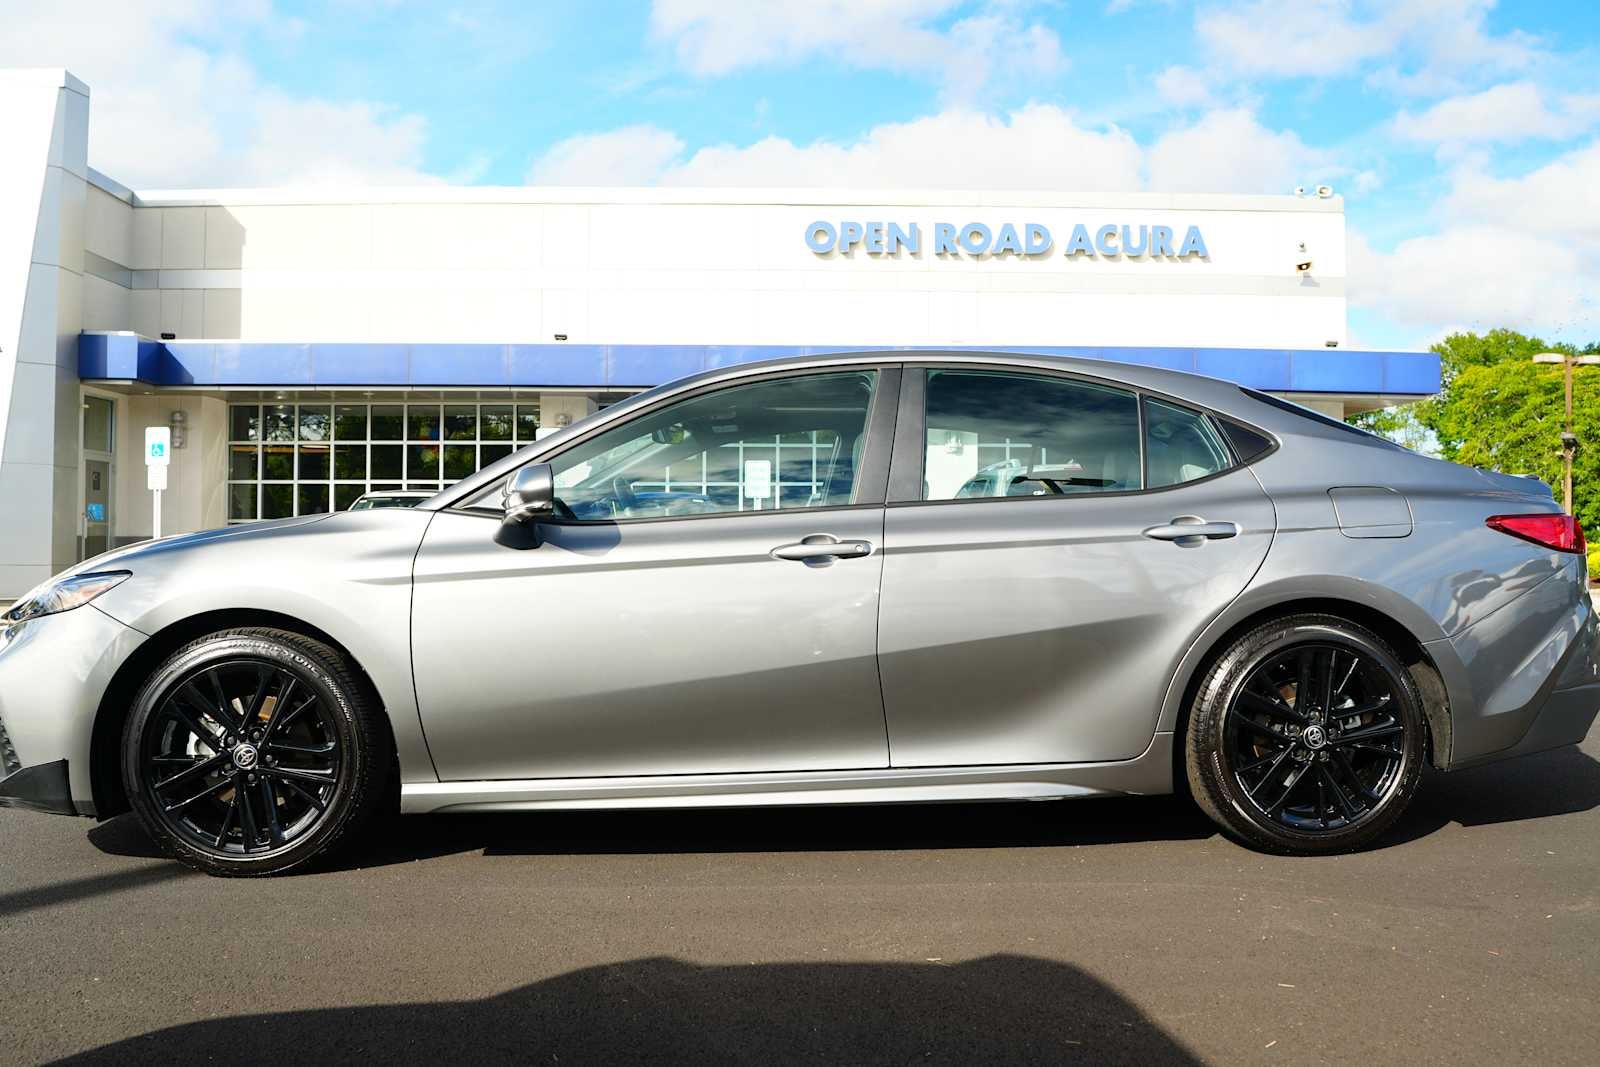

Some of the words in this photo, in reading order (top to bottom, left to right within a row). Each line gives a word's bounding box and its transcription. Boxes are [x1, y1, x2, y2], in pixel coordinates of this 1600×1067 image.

[804, 220, 918, 255] OPEN
[934, 222, 1052, 256] ROAD
[1064, 223, 1209, 257] ACURA
